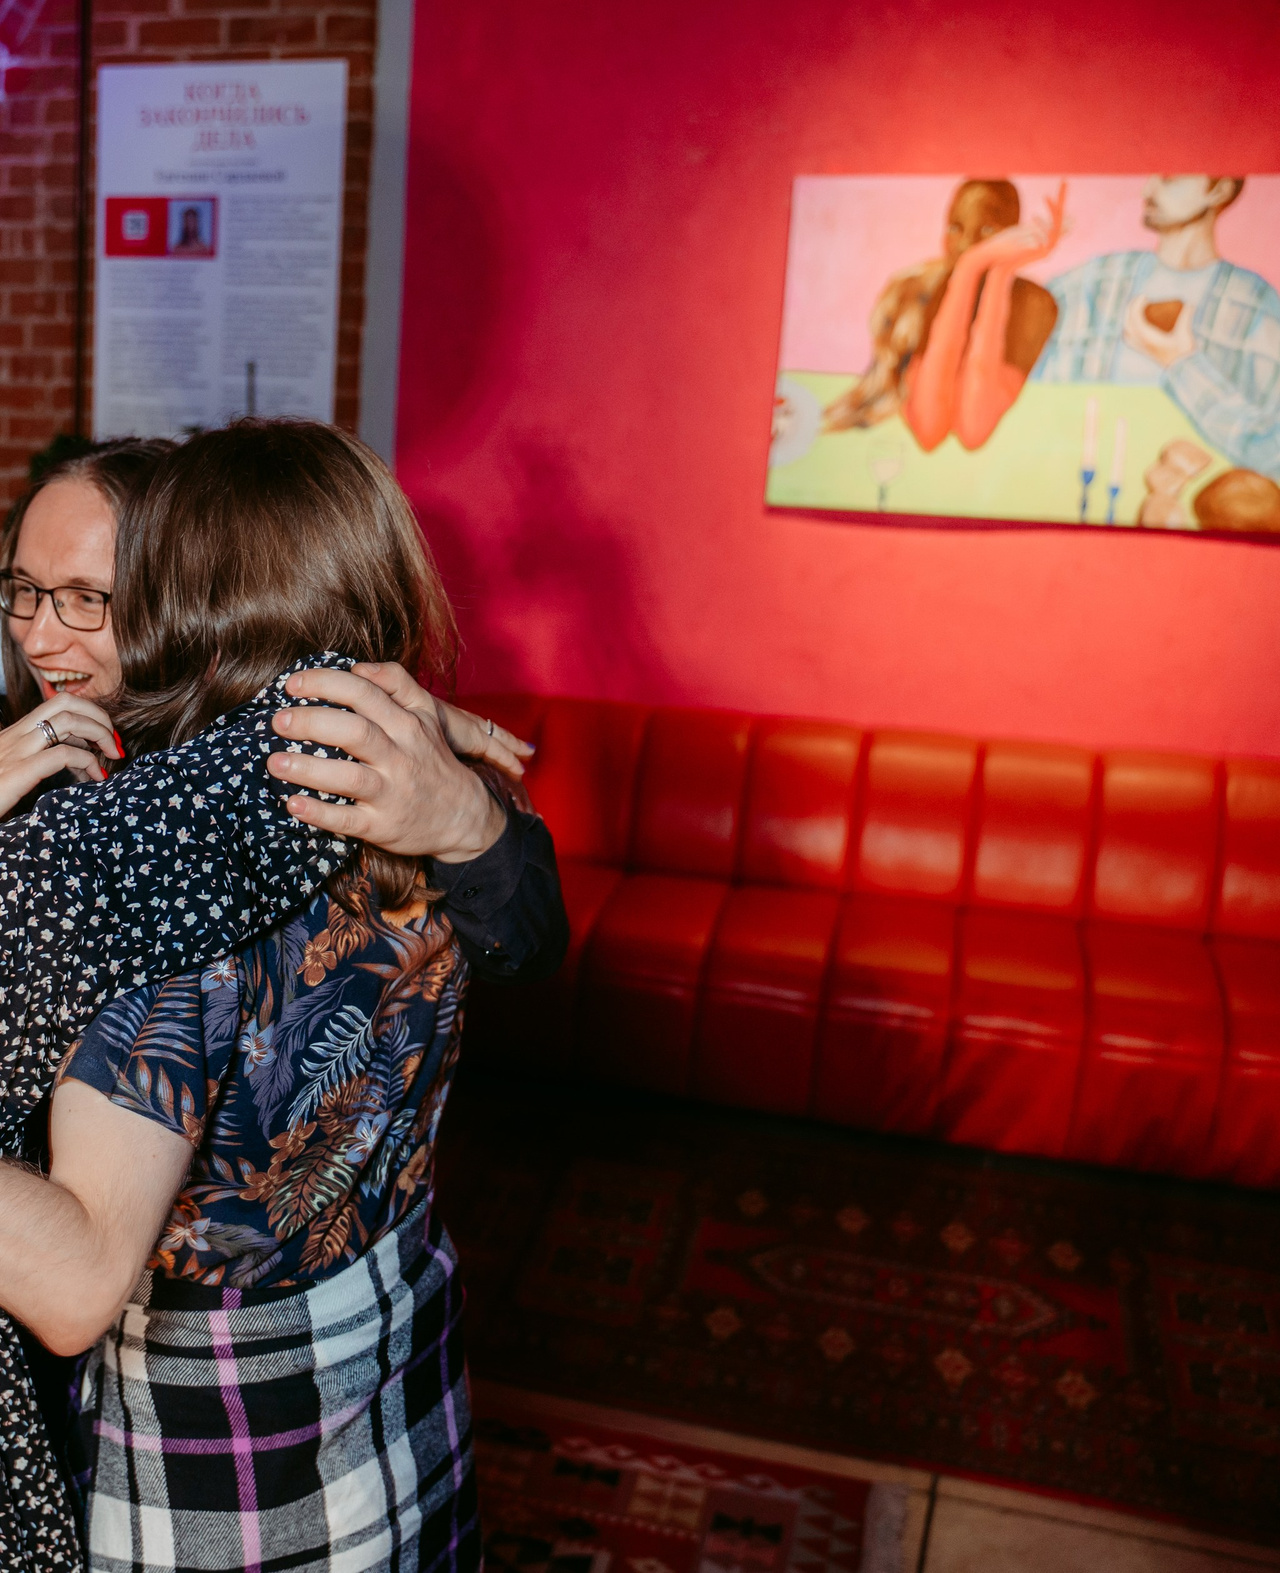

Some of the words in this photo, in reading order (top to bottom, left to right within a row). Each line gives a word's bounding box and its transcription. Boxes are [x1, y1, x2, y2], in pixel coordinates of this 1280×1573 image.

[184, 81, 261, 103] КОГДА
[136, 104, 310, 126] ЗАКОНЧИЛИСЬ
[192, 129, 256, 151] ДЕЛА
